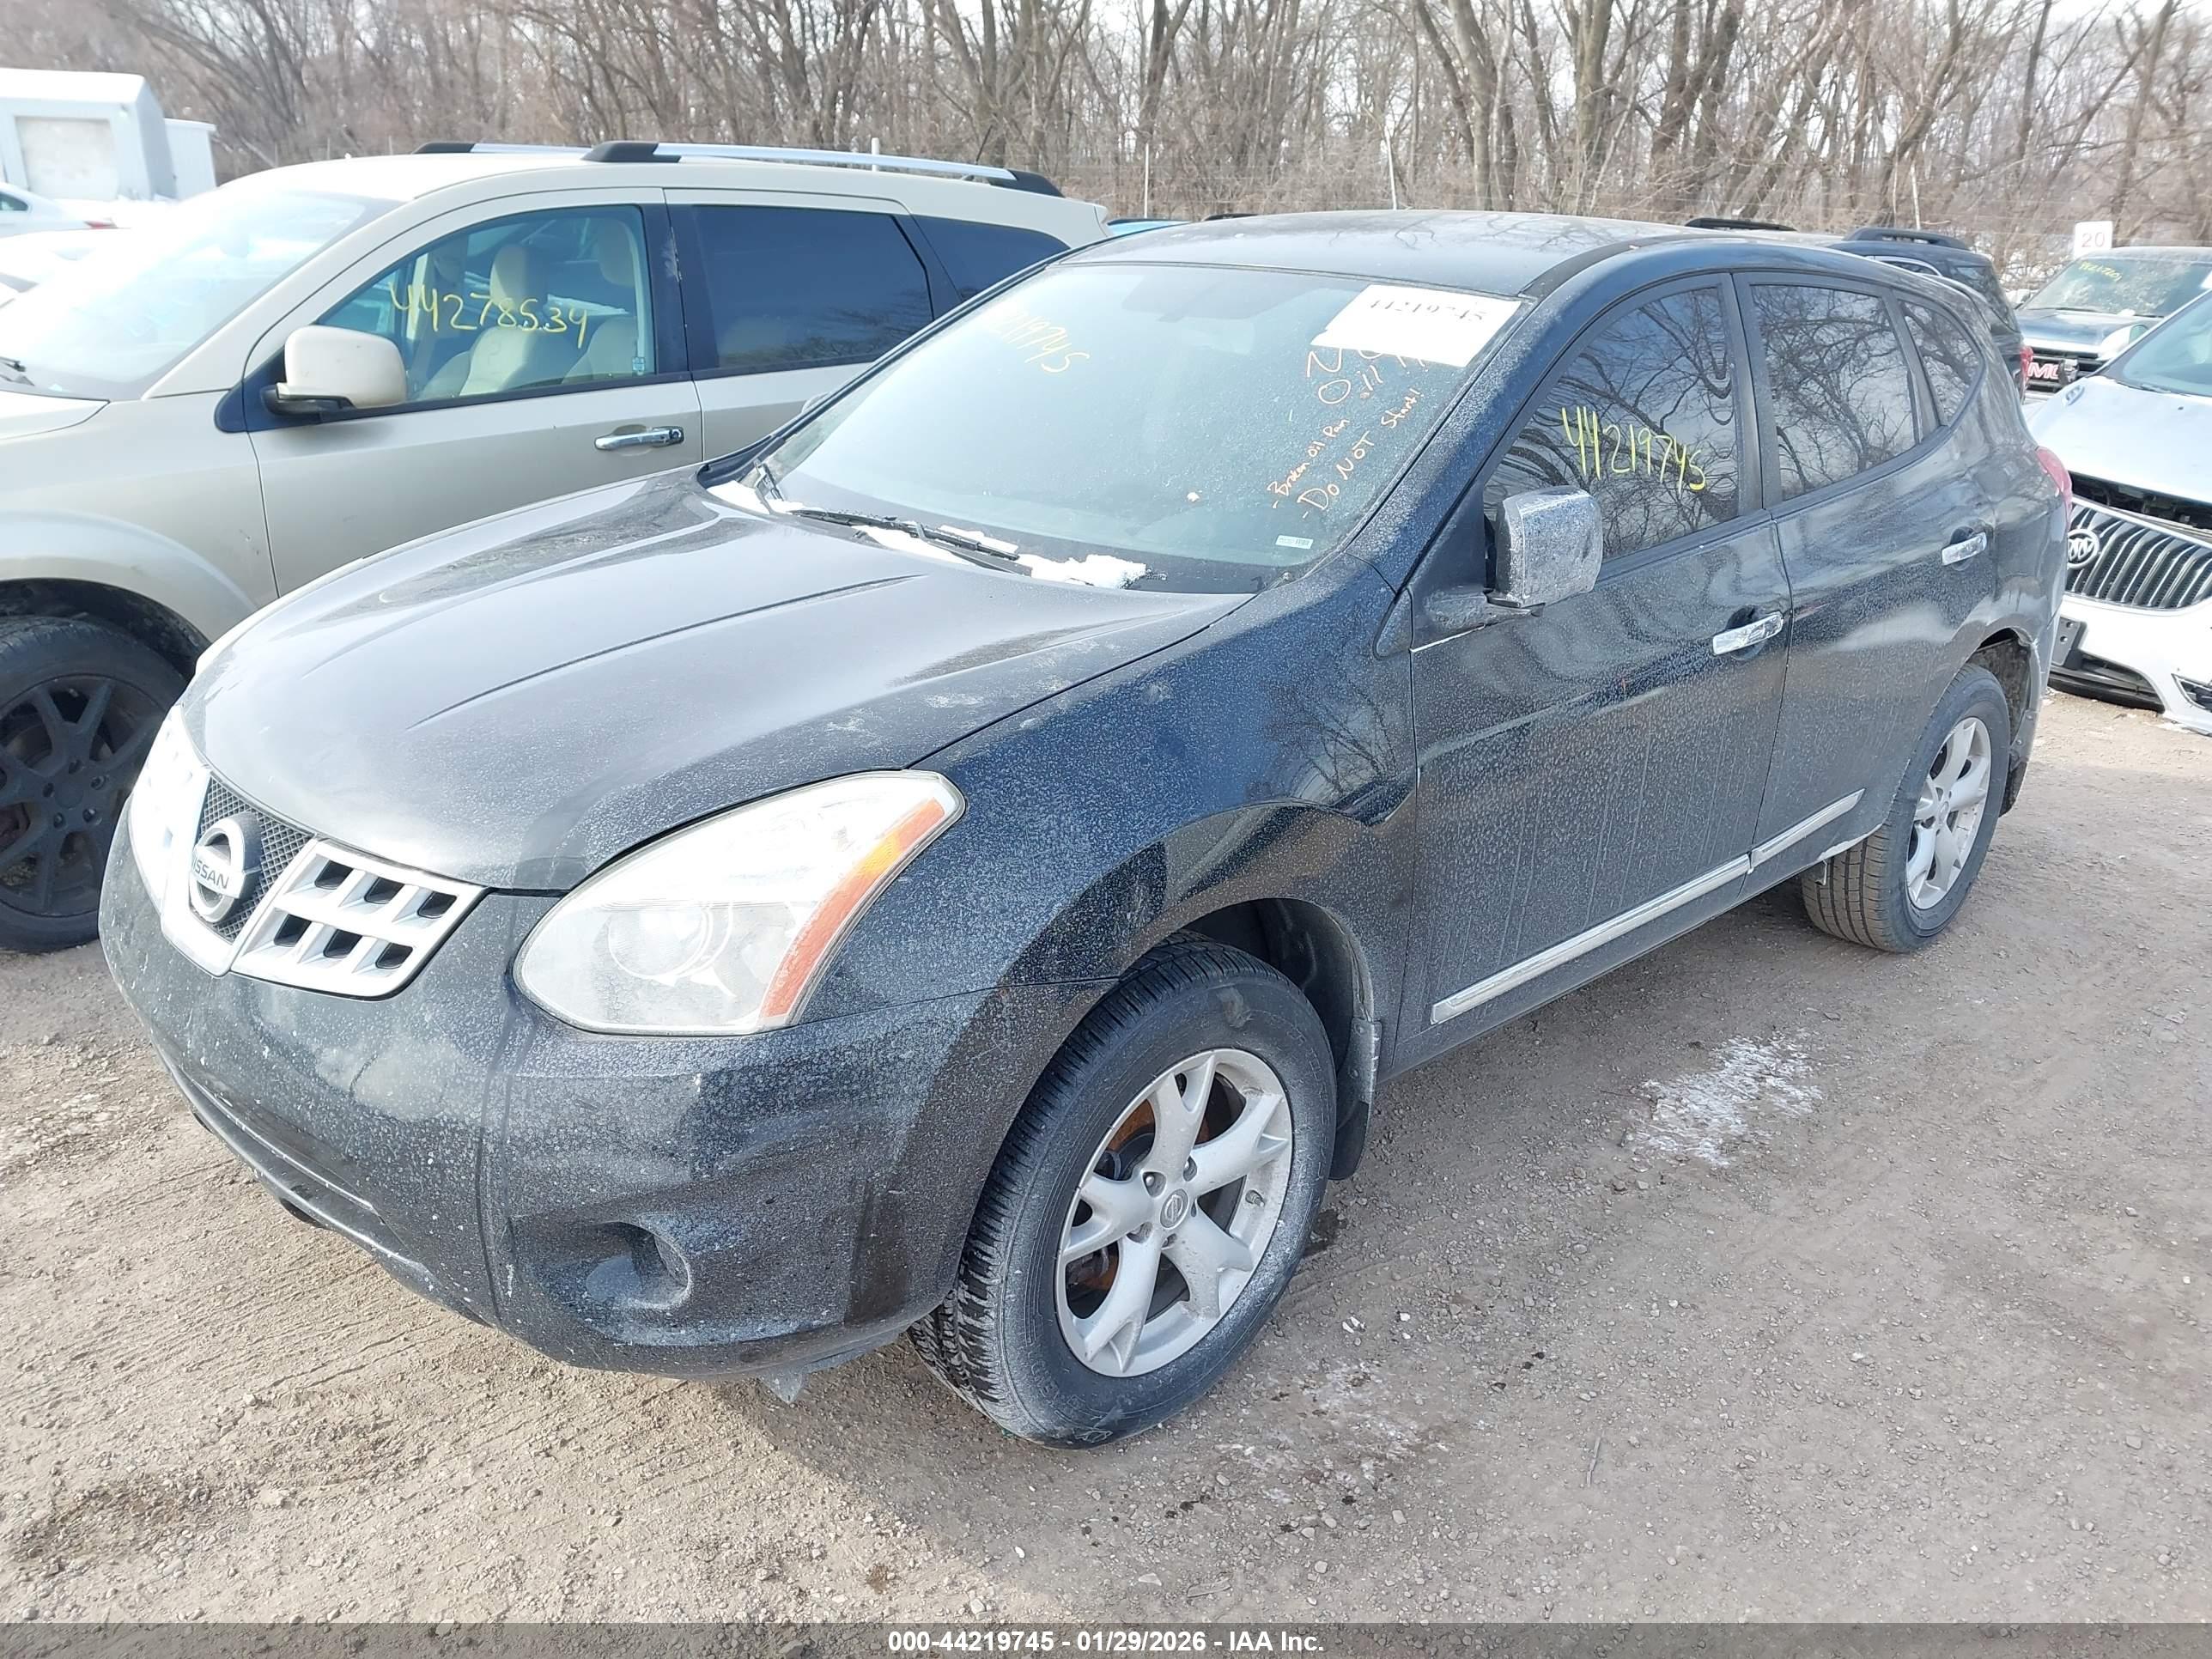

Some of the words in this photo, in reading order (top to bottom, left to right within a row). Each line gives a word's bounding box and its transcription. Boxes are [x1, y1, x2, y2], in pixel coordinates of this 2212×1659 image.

[2081, 232, 2106, 248] 20
[388, 281, 587, 349] 44278534
[2026, 361, 2060, 380] MC
[1561, 405, 1705, 499] 44219745
[191, 857, 230, 890] ISSAN
